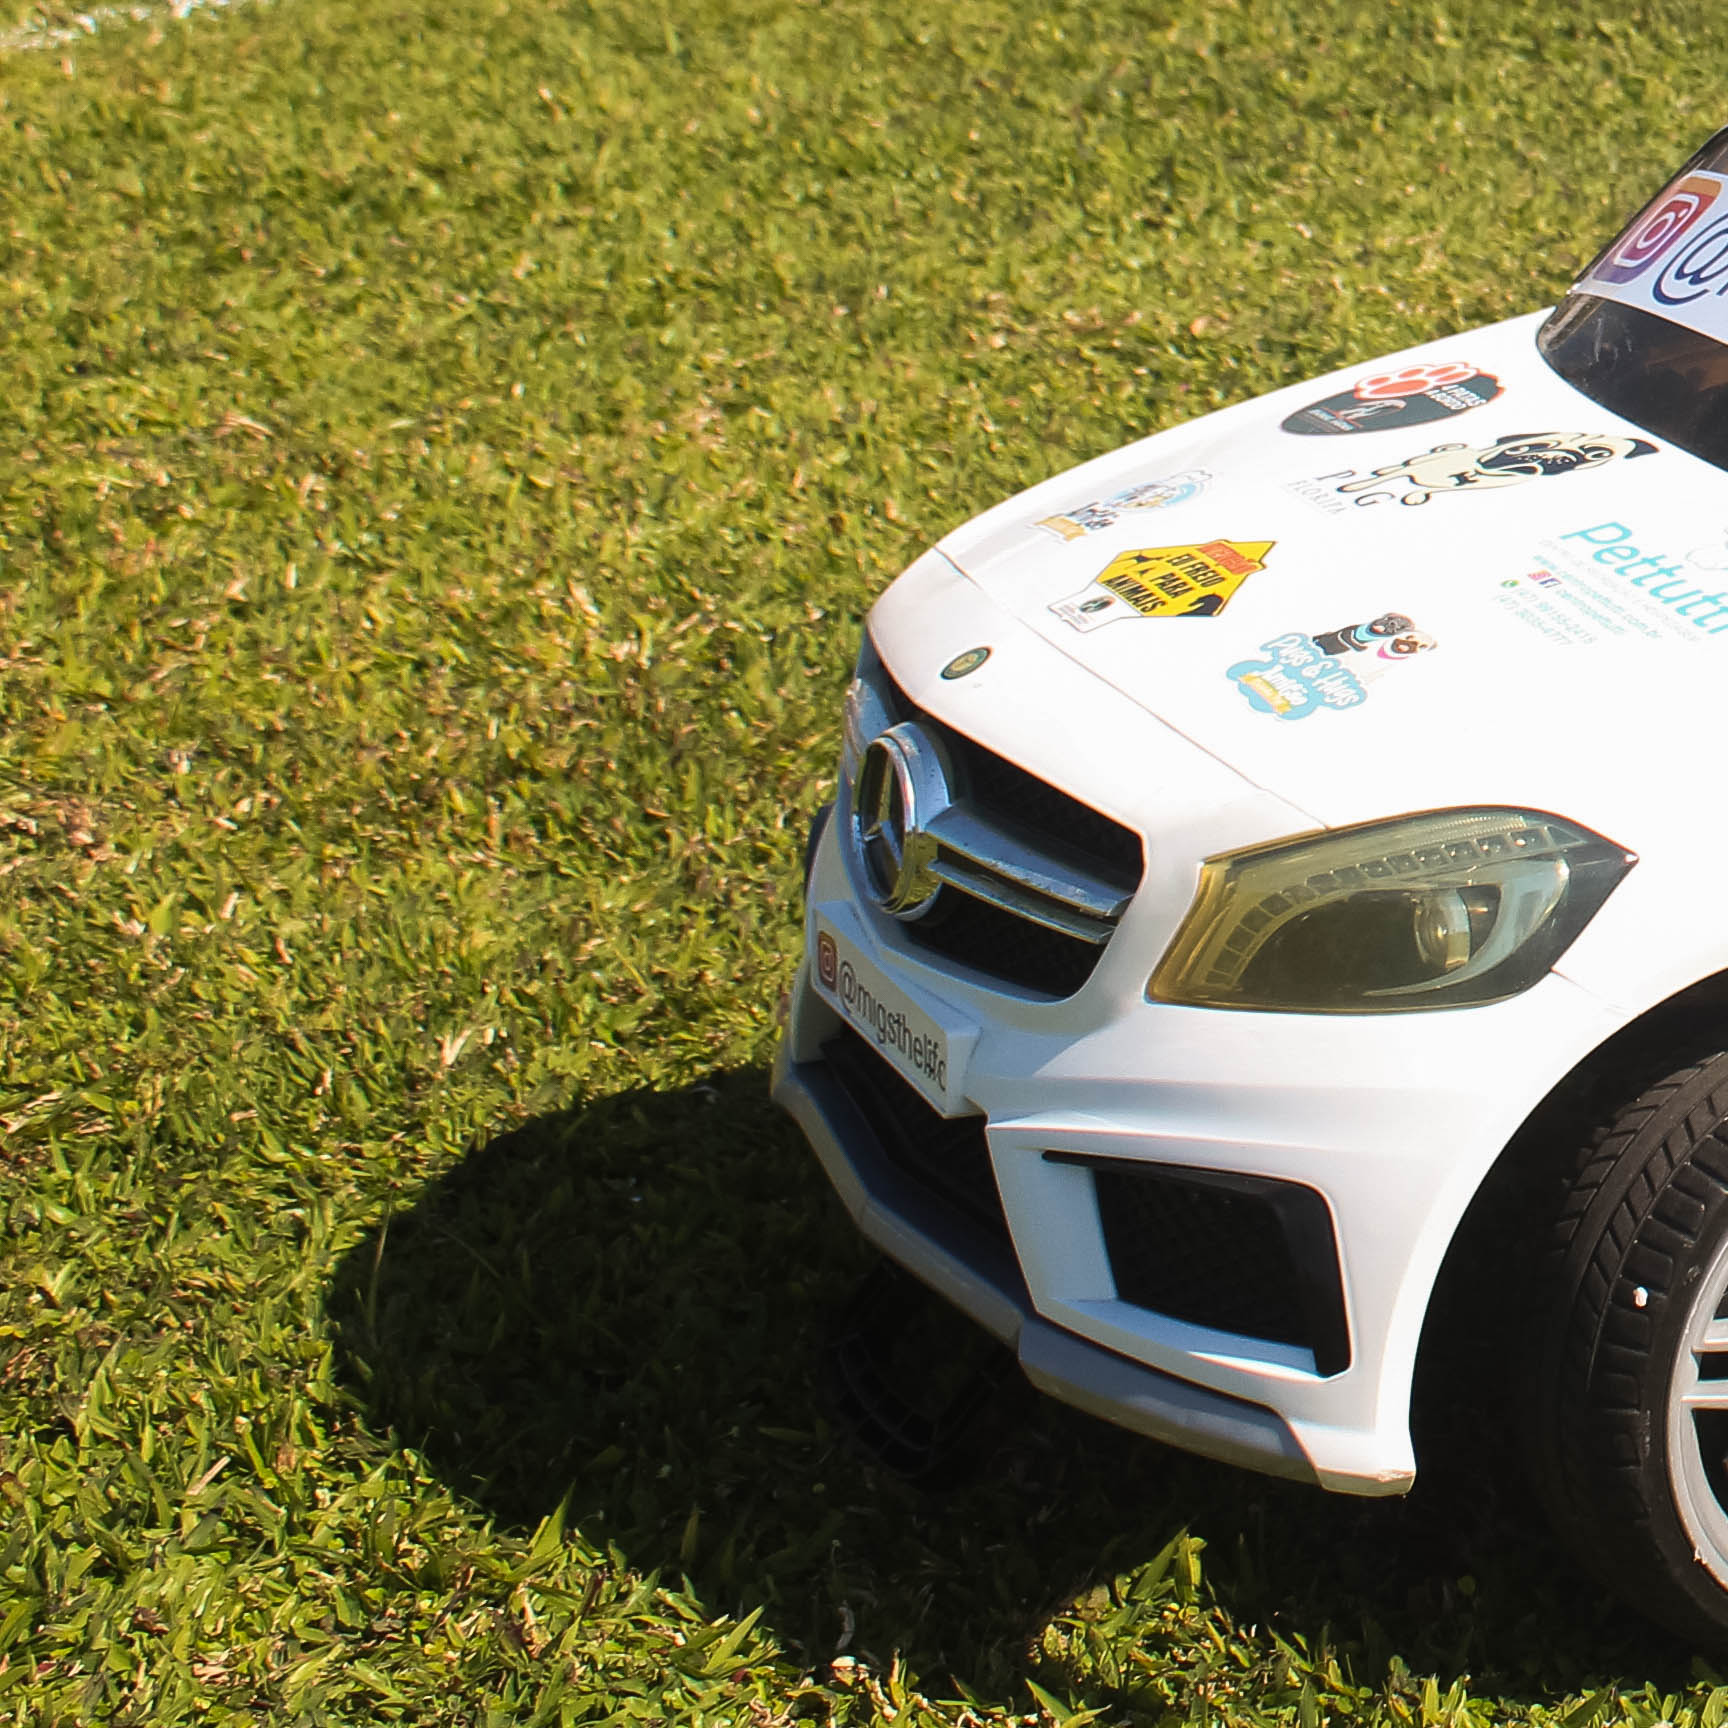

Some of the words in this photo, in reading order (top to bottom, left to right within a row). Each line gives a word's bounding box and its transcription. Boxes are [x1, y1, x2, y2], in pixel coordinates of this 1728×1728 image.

[1151, 571, 1195, 599] PARA
[1188, 560, 1228, 588] FREIO
[1101, 573, 1168, 613] ANIMAIS
